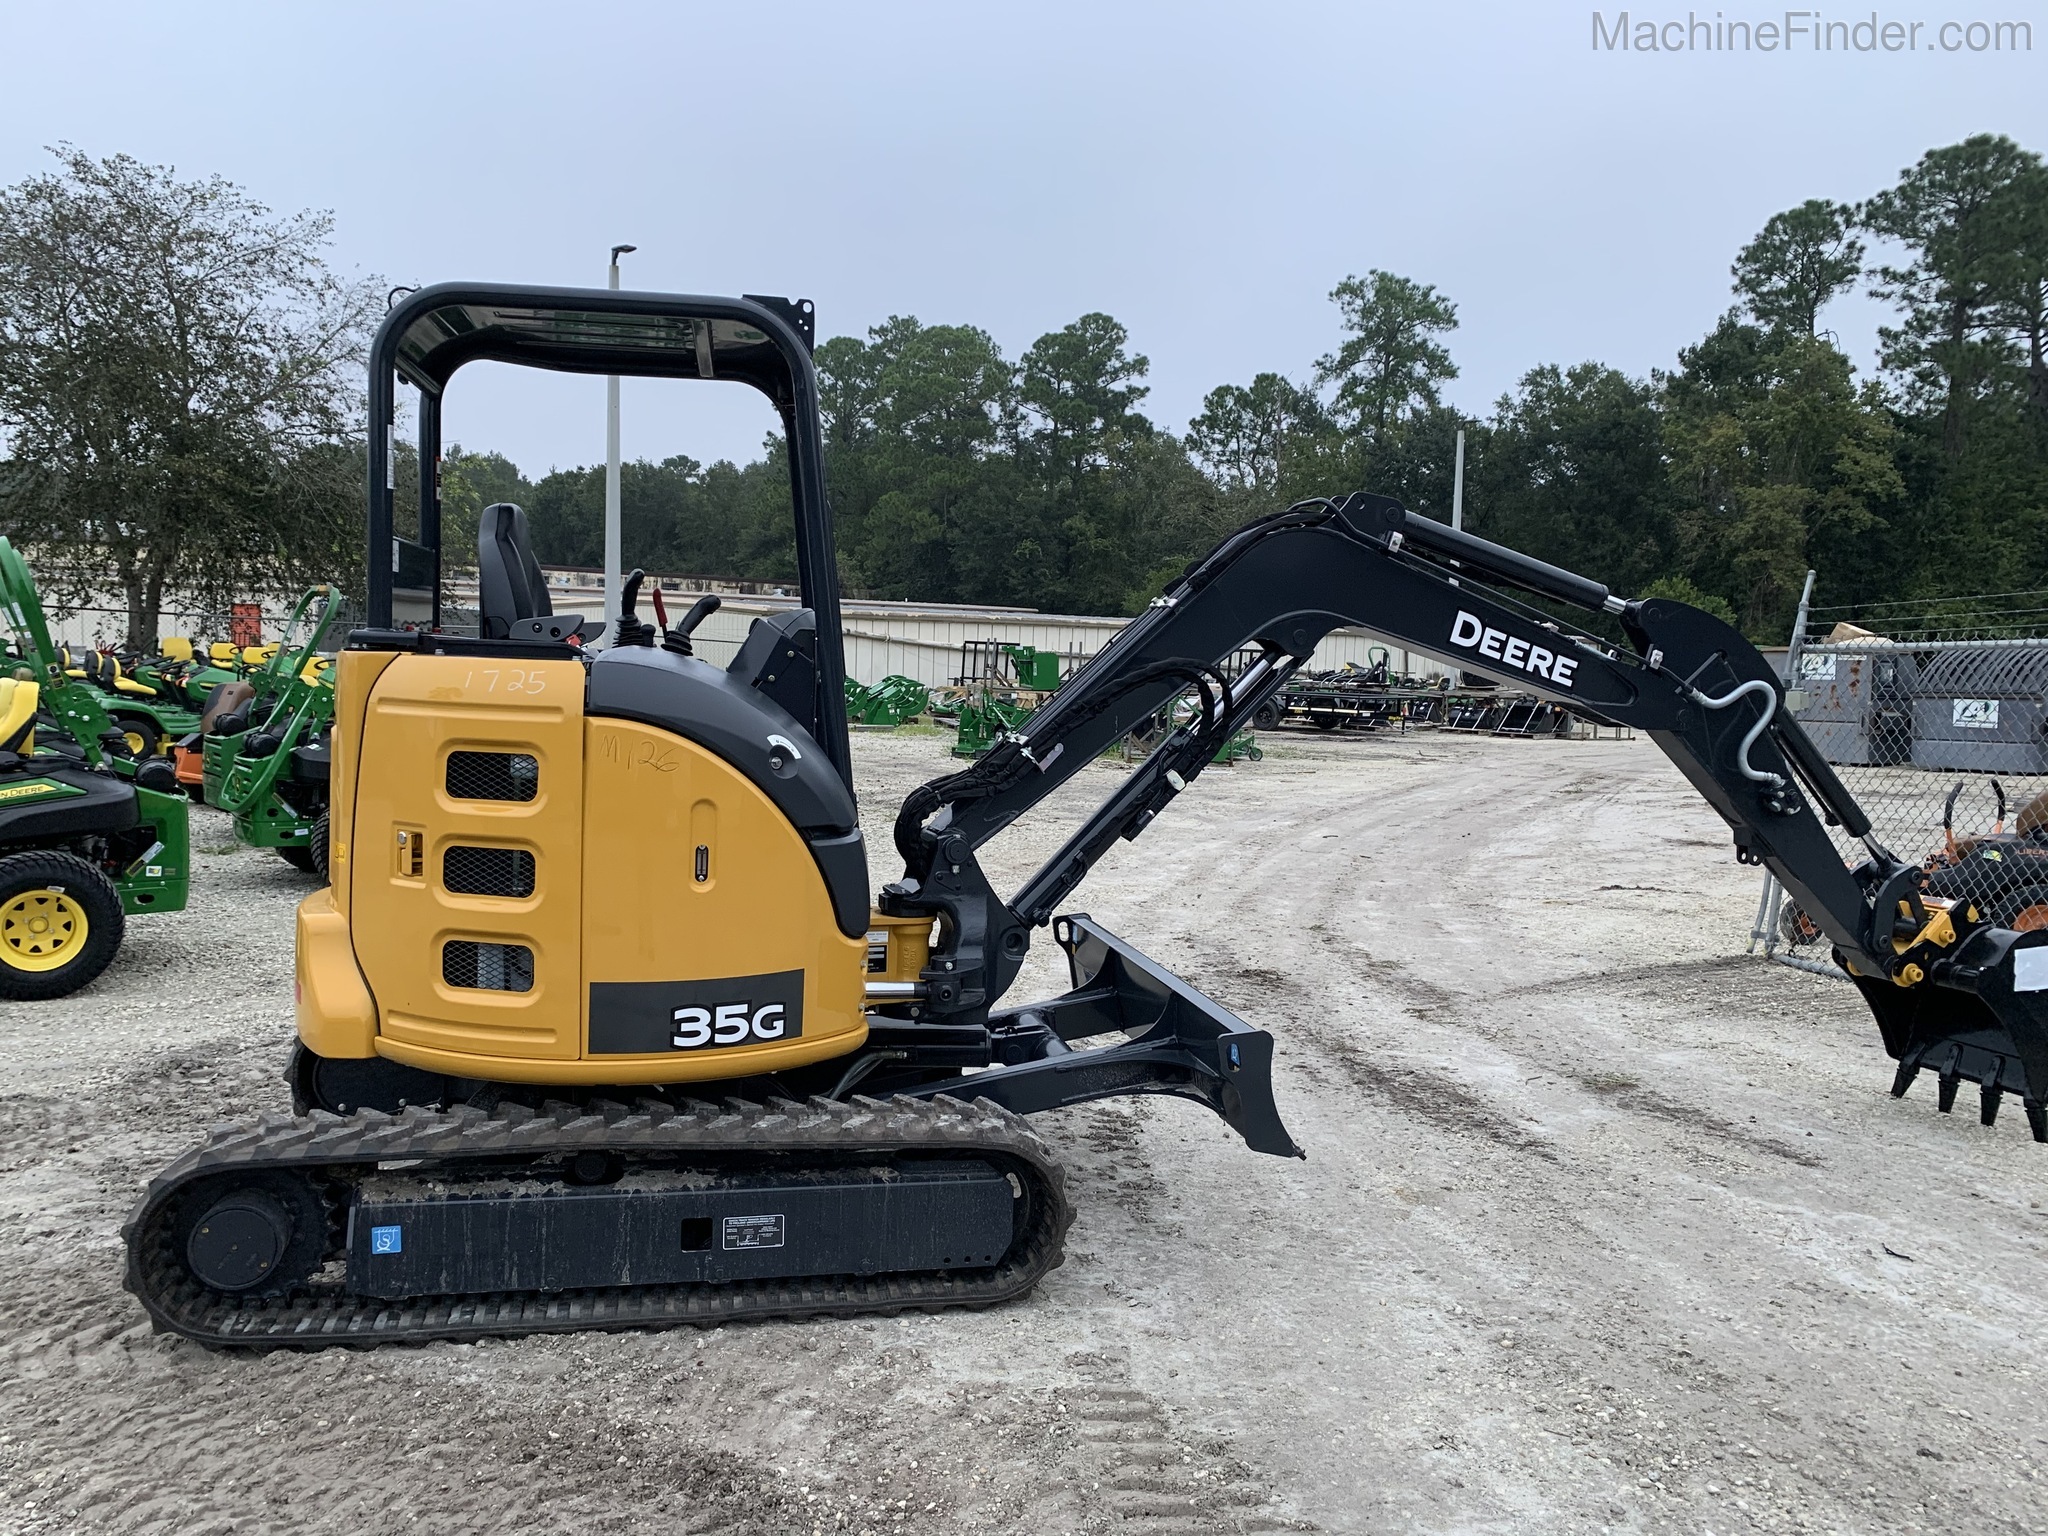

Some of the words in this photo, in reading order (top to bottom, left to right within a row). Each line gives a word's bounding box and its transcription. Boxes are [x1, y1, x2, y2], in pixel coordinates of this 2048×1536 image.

[1450, 610, 1579, 687] DEERE
[465, 669, 546, 695] 1725
[10, 786, 44, 797] DEERE
[673, 1003, 785, 1048] 35G
